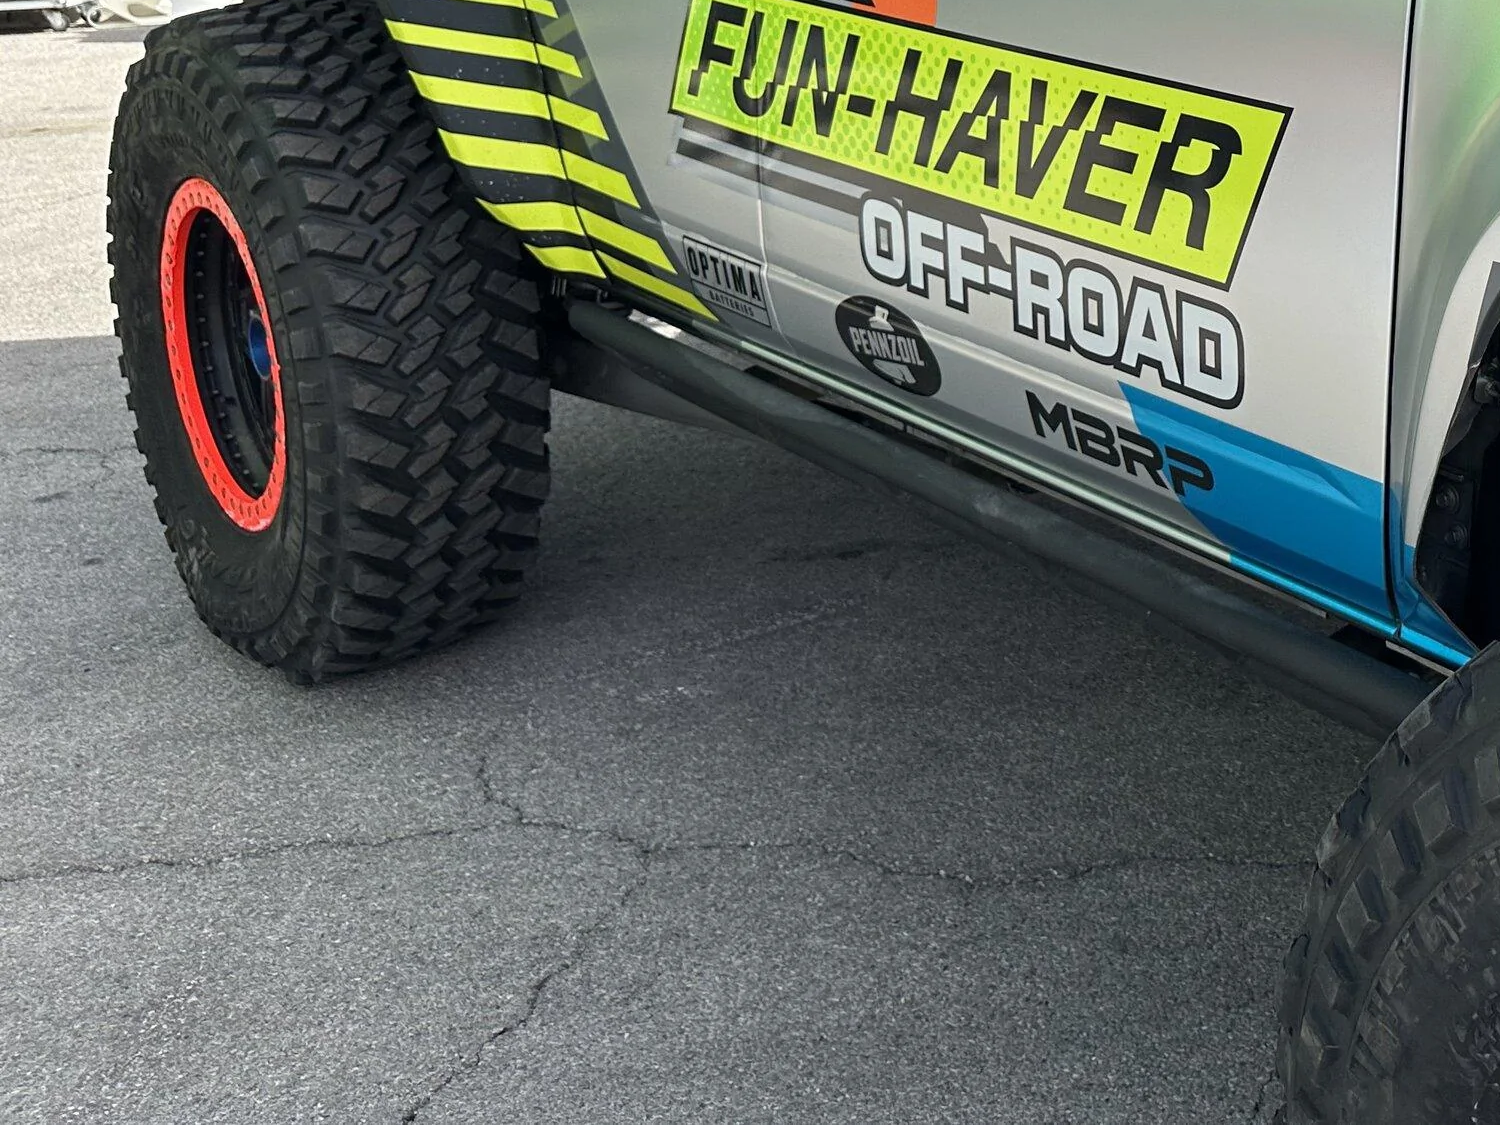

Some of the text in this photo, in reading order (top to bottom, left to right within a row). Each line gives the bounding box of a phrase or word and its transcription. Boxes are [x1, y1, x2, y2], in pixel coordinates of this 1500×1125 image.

[687, 0, 1243, 251] FUN-HAVER
[687, 245, 762, 303] OPTIMA
[709, 289, 755, 317] BATTERIES
[860, 196, 1242, 406] OFF-ROAD
[848, 325, 926, 367] PENNZOIL
[1025, 389, 1215, 496] MBRP
